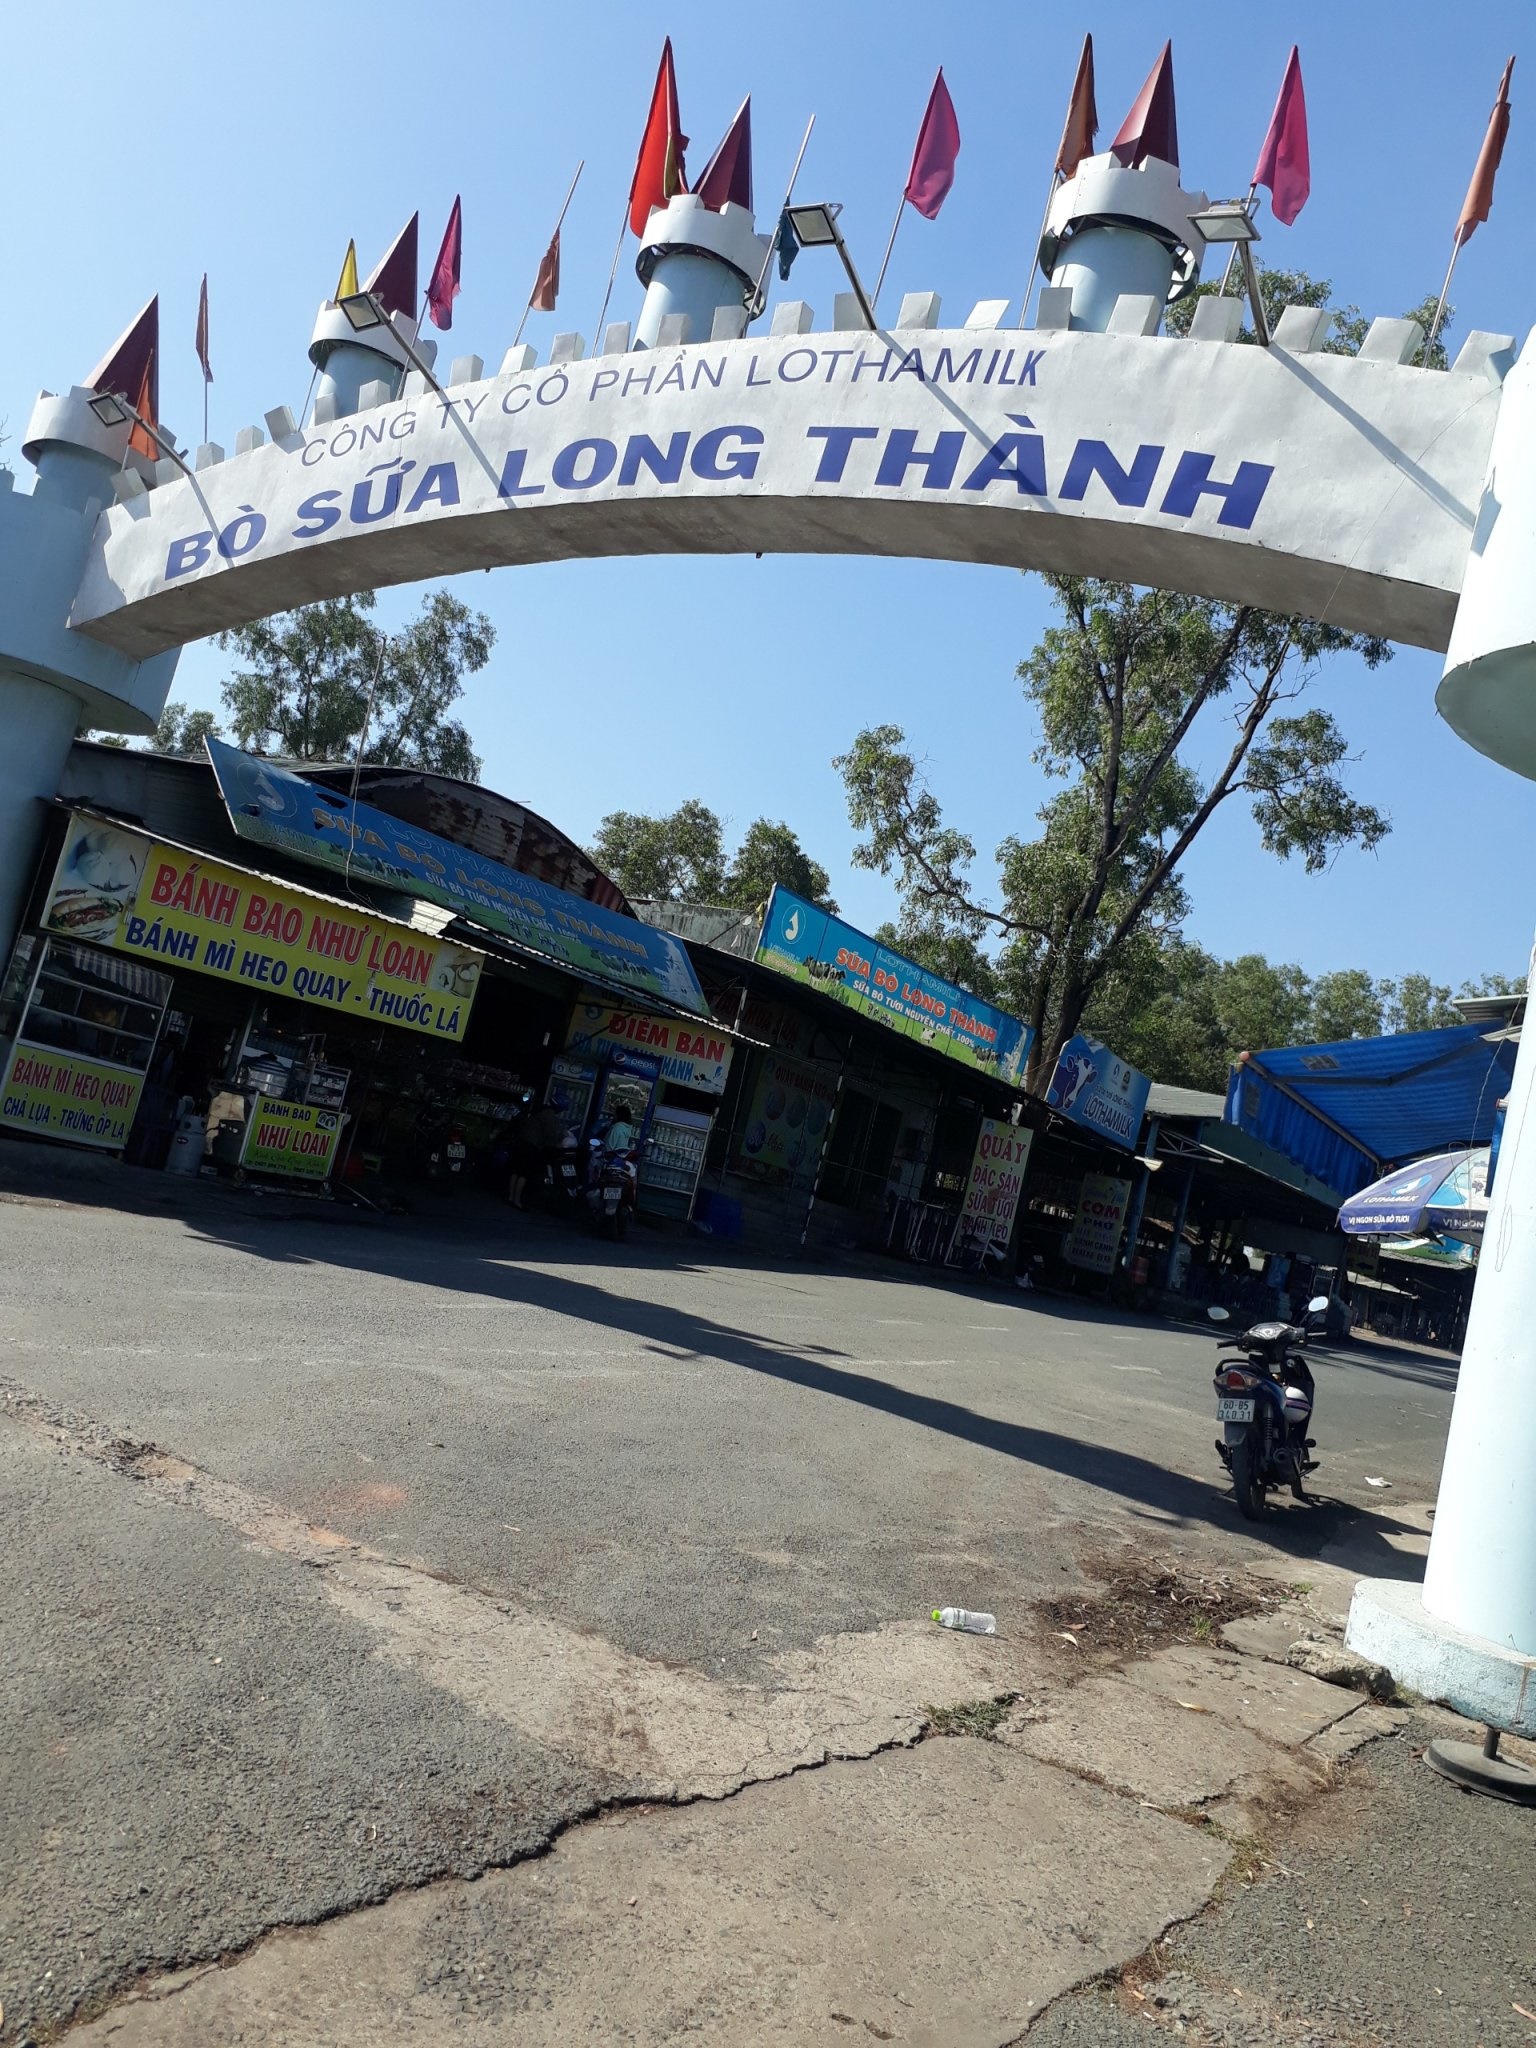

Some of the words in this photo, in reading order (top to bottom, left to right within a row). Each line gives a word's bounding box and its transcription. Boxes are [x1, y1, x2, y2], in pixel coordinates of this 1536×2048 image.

[301, 411, 417, 466] CÔNG
[436, 392, 490, 429] TY
[501, 363, 568, 416] CỔ
[589, 348, 727, 401] PHẦN
[746, 347, 1047, 387] LOTHAMILK
[164, 504, 267, 581] BÒ
[291, 456, 461, 539] SỮA
[497, 425, 764, 499] LONG
[806, 413, 1275, 530] THÀNH
[312, 807, 390, 853] SỮA
[395, 840, 446, 873] BÒ
[455, 868, 546, 916] LONG
[552, 908, 648, 959] THÀNH
[151, 863, 241, 926] BÁNH
[242, 893, 303, 946] BAO
[307, 915, 371, 965] NHƯ
[366, 935, 434, 986] LOAN
[125, 916, 199, 961] BÁNH
[203, 939, 237, 971] MÌ
[239, 950, 288, 986] HEO
[293, 966, 351, 1003] QUAY
[369, 987, 433, 1026] THUỐC
[436, 1005, 461, 1034] LÁ
[835, 947, 871, 978] SỮA
[873, 967, 898, 992] BÒ
[901, 983, 946, 1017] LONG
[949, 1007, 998, 1043] THÀNH
[853, 980, 869, 995] SỮA
[886, 997, 904, 1012] TƯƠI
[608, 1014, 669, 1048] ĐIỂM
[676, 1032, 725, 1062] BÁN
[12, 1054, 53, 1089] BÁNH
[53, 1064, 73, 1094] MÌ
[72, 1072, 100, 1100] HEO
[101, 1080, 135, 1109] QUAY
[3, 1093, 29, 1118] CHẢ
[28, 1102, 51, 1125] LỤA
[60, 1107, 95, 1132] TRỨNG
[291, 1107, 312, 1121] BAO
[1082, 1095, 1134, 1139] LOTHAMILK
[256, 1124, 293, 1150] NHƯ
[292, 1130, 331, 1157] LOAN
[997, 1167, 1020, 1194] SẢN
[1363, 1195, 1418, 1203] LOTHAMILK
[1356, 1215, 1372, 1223] NGON
[1373, 1213, 1385, 1222] SỮA
[1453, 1218, 1484, 1229] NGON
